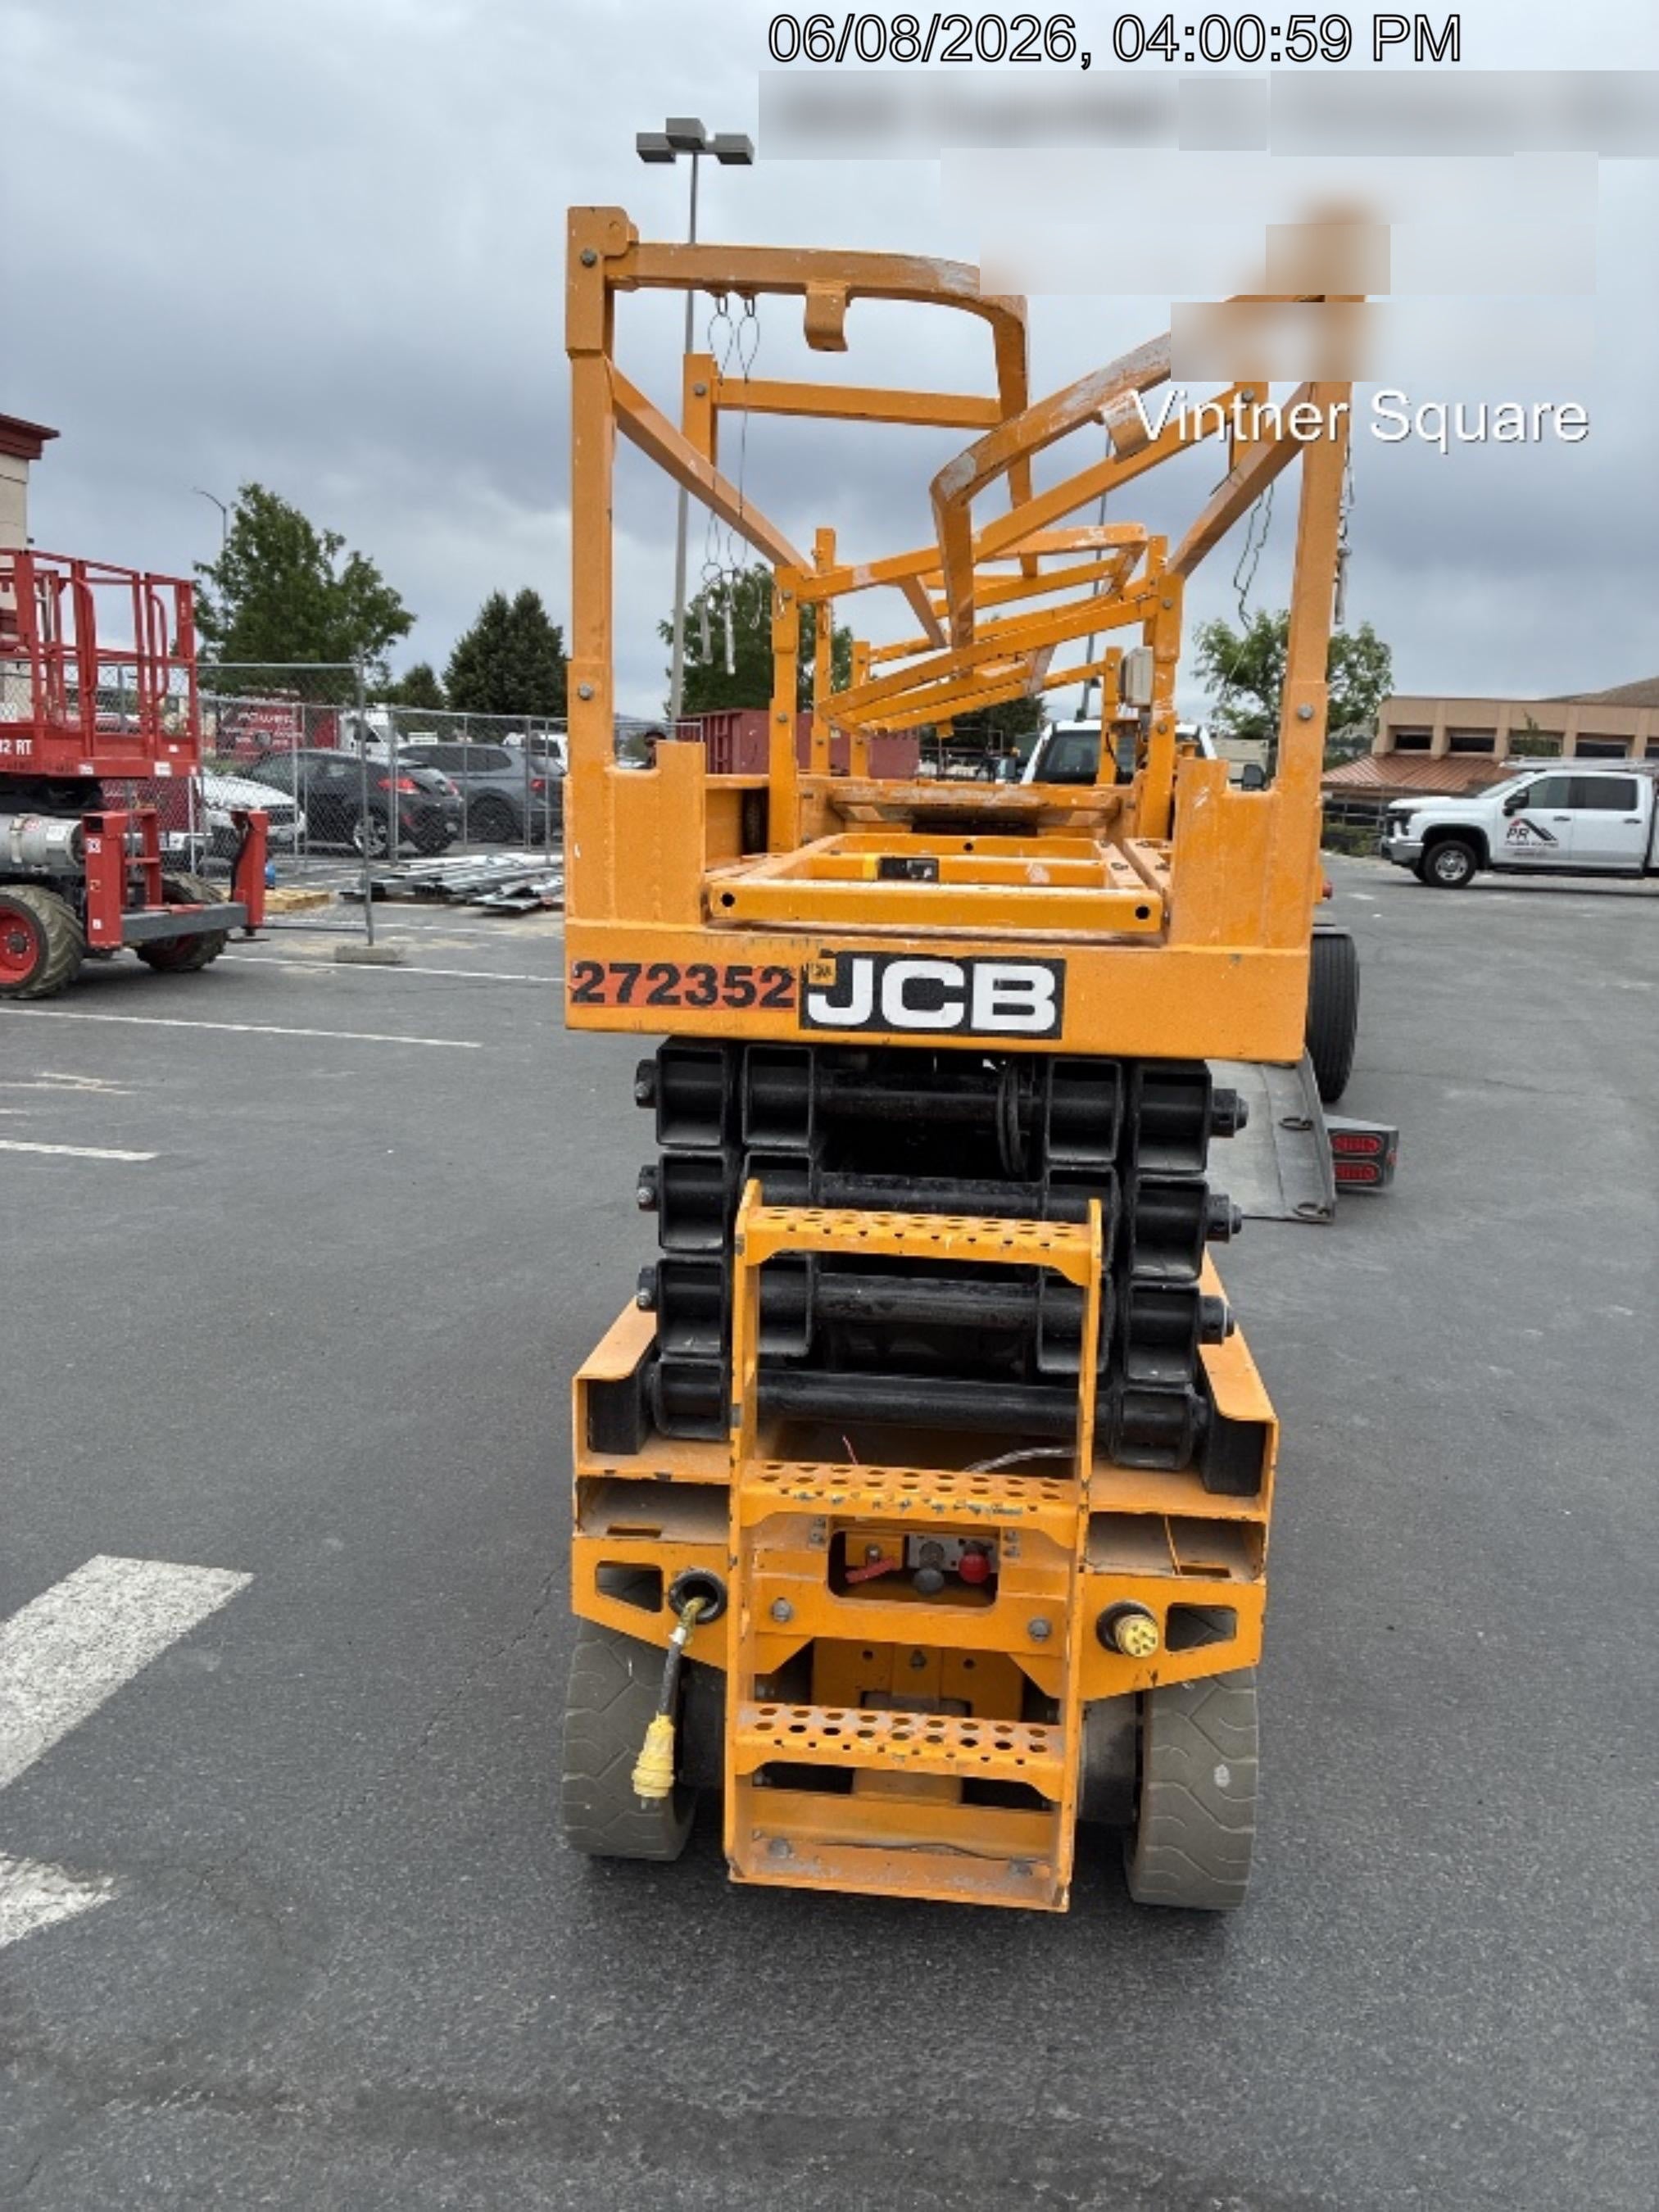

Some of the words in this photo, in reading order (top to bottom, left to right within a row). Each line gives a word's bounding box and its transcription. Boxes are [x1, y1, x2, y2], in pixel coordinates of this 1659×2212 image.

[16, 739, 32, 755] RT
[573, 961, 795, 1008] 272352
[807, 957, 1058, 1032] JCB
